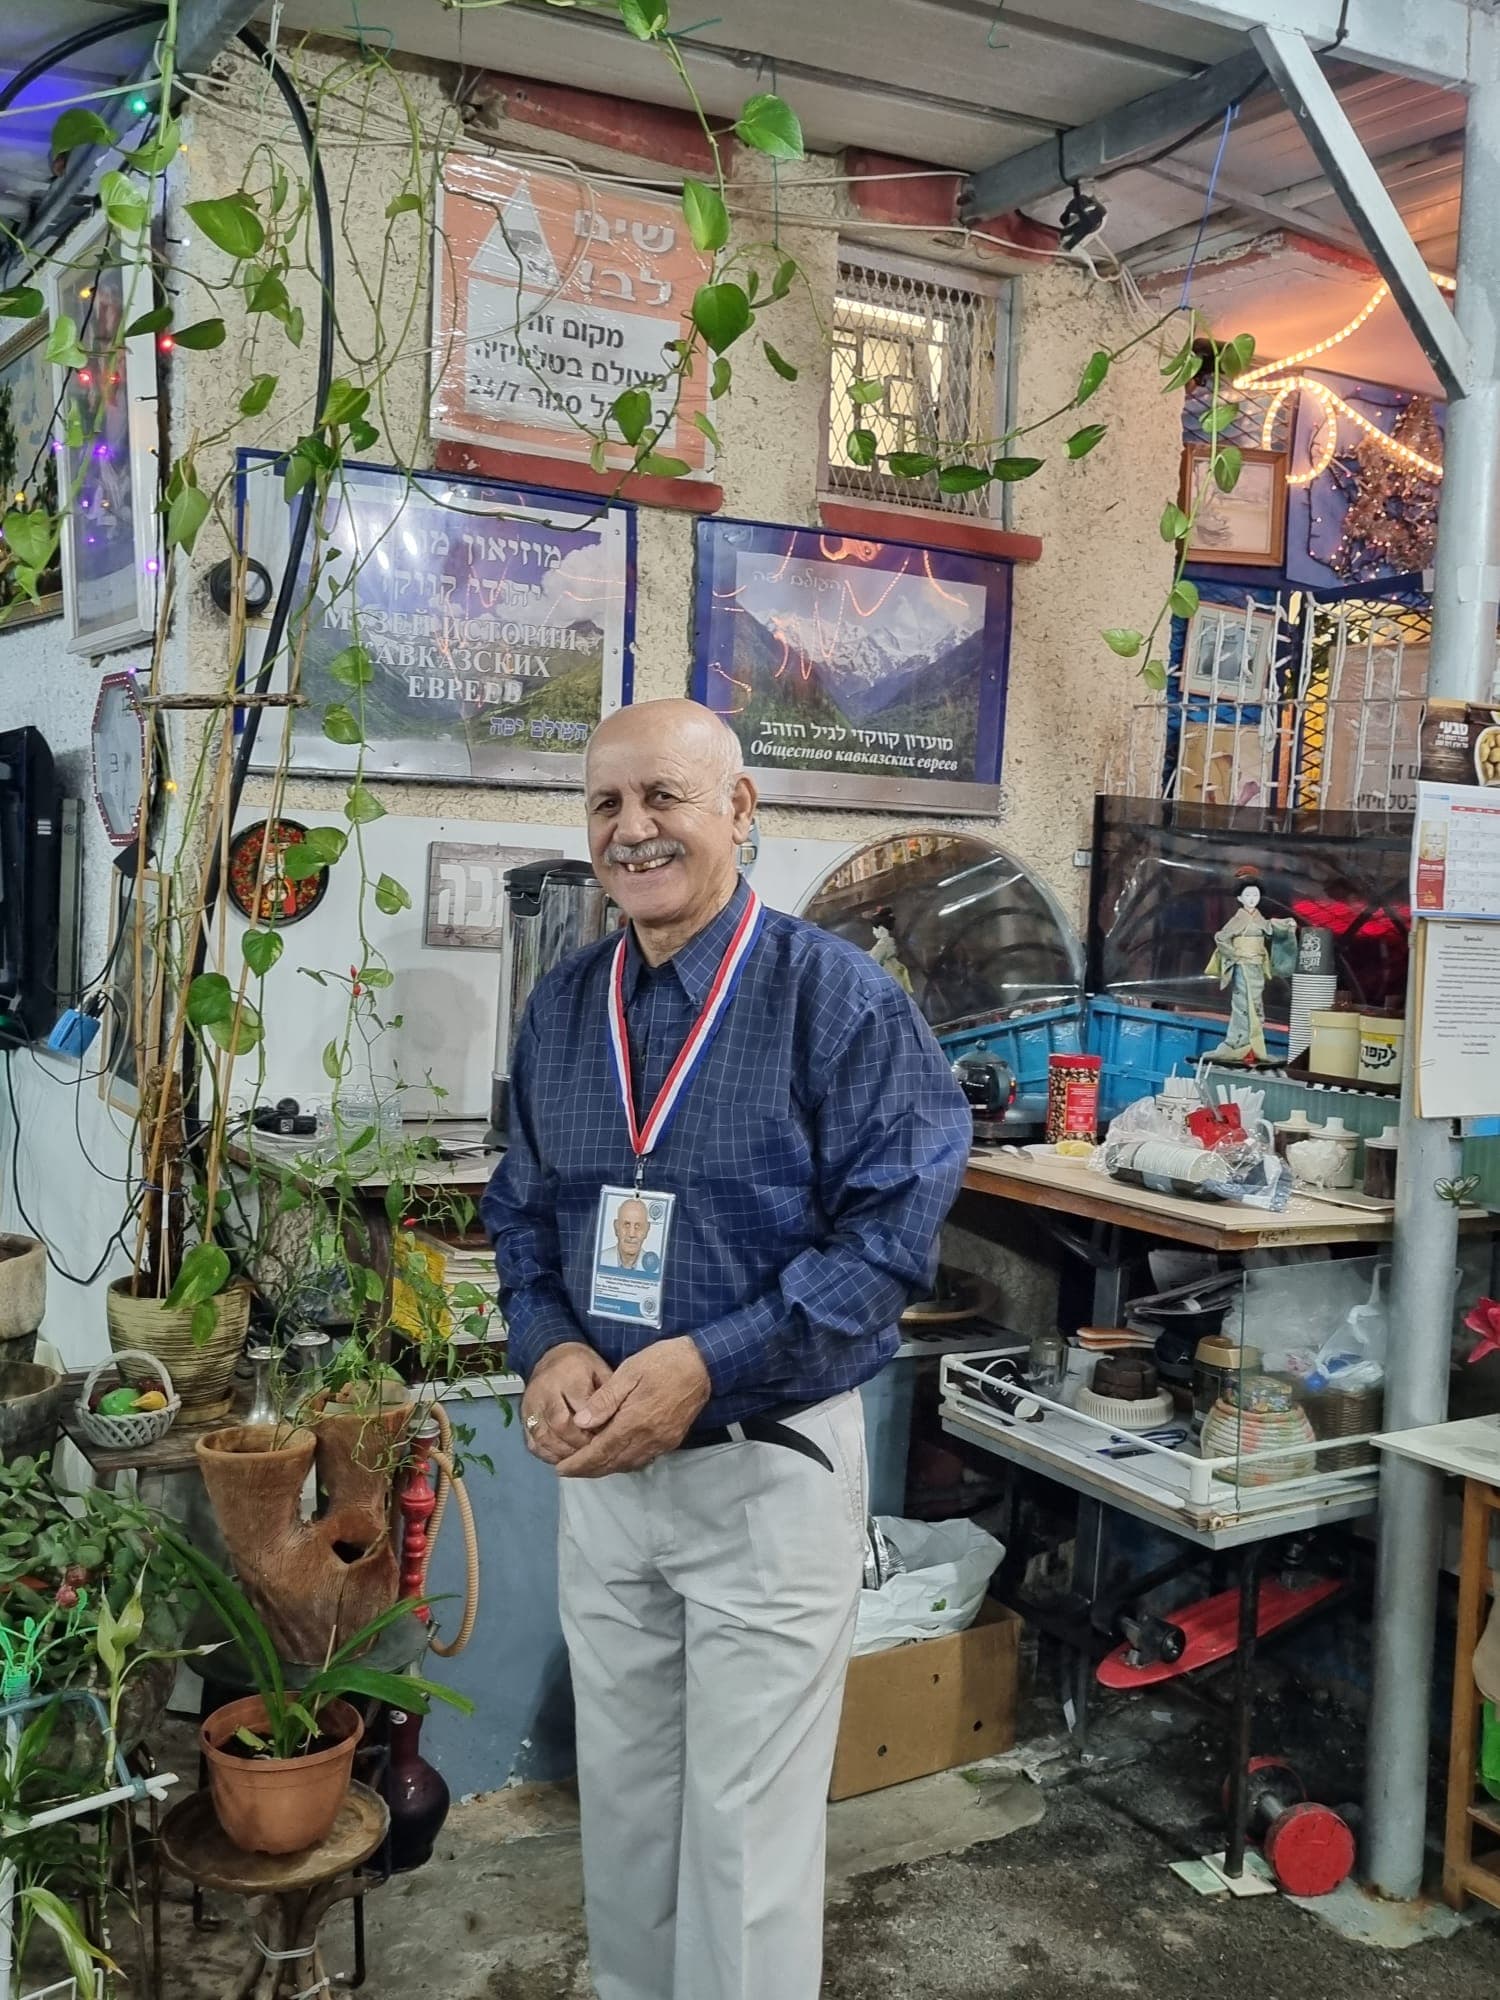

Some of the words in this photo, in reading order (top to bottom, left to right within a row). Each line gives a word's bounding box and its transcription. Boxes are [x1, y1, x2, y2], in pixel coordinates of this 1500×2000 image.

[574, 209, 675, 253] שים
[527, 313, 556, 335] זה
[562, 319, 625, 349] מקום
[468, 374, 521, 403] 24/7
[591, 359, 669, 393] מצולם
[528, 385, 583, 414] סגור
[462, 533, 562, 570] מוזיאון
[468, 577, 544, 608] יהודי
[323, 605, 439, 637] МУЗЕЙ
[442, 616, 579, 653] ИСТОРИИ
[489, 716, 525, 737] יפה
[760, 721, 807, 738] הזהב
[811, 722, 847, 742] לגיל
[851, 728, 900, 749] קווקזי
[750, 739, 833, 760] Общество
[835, 751, 915, 768] кавказских
[917, 757, 958, 773] евреев
[904, 733, 954, 751] מועדון
